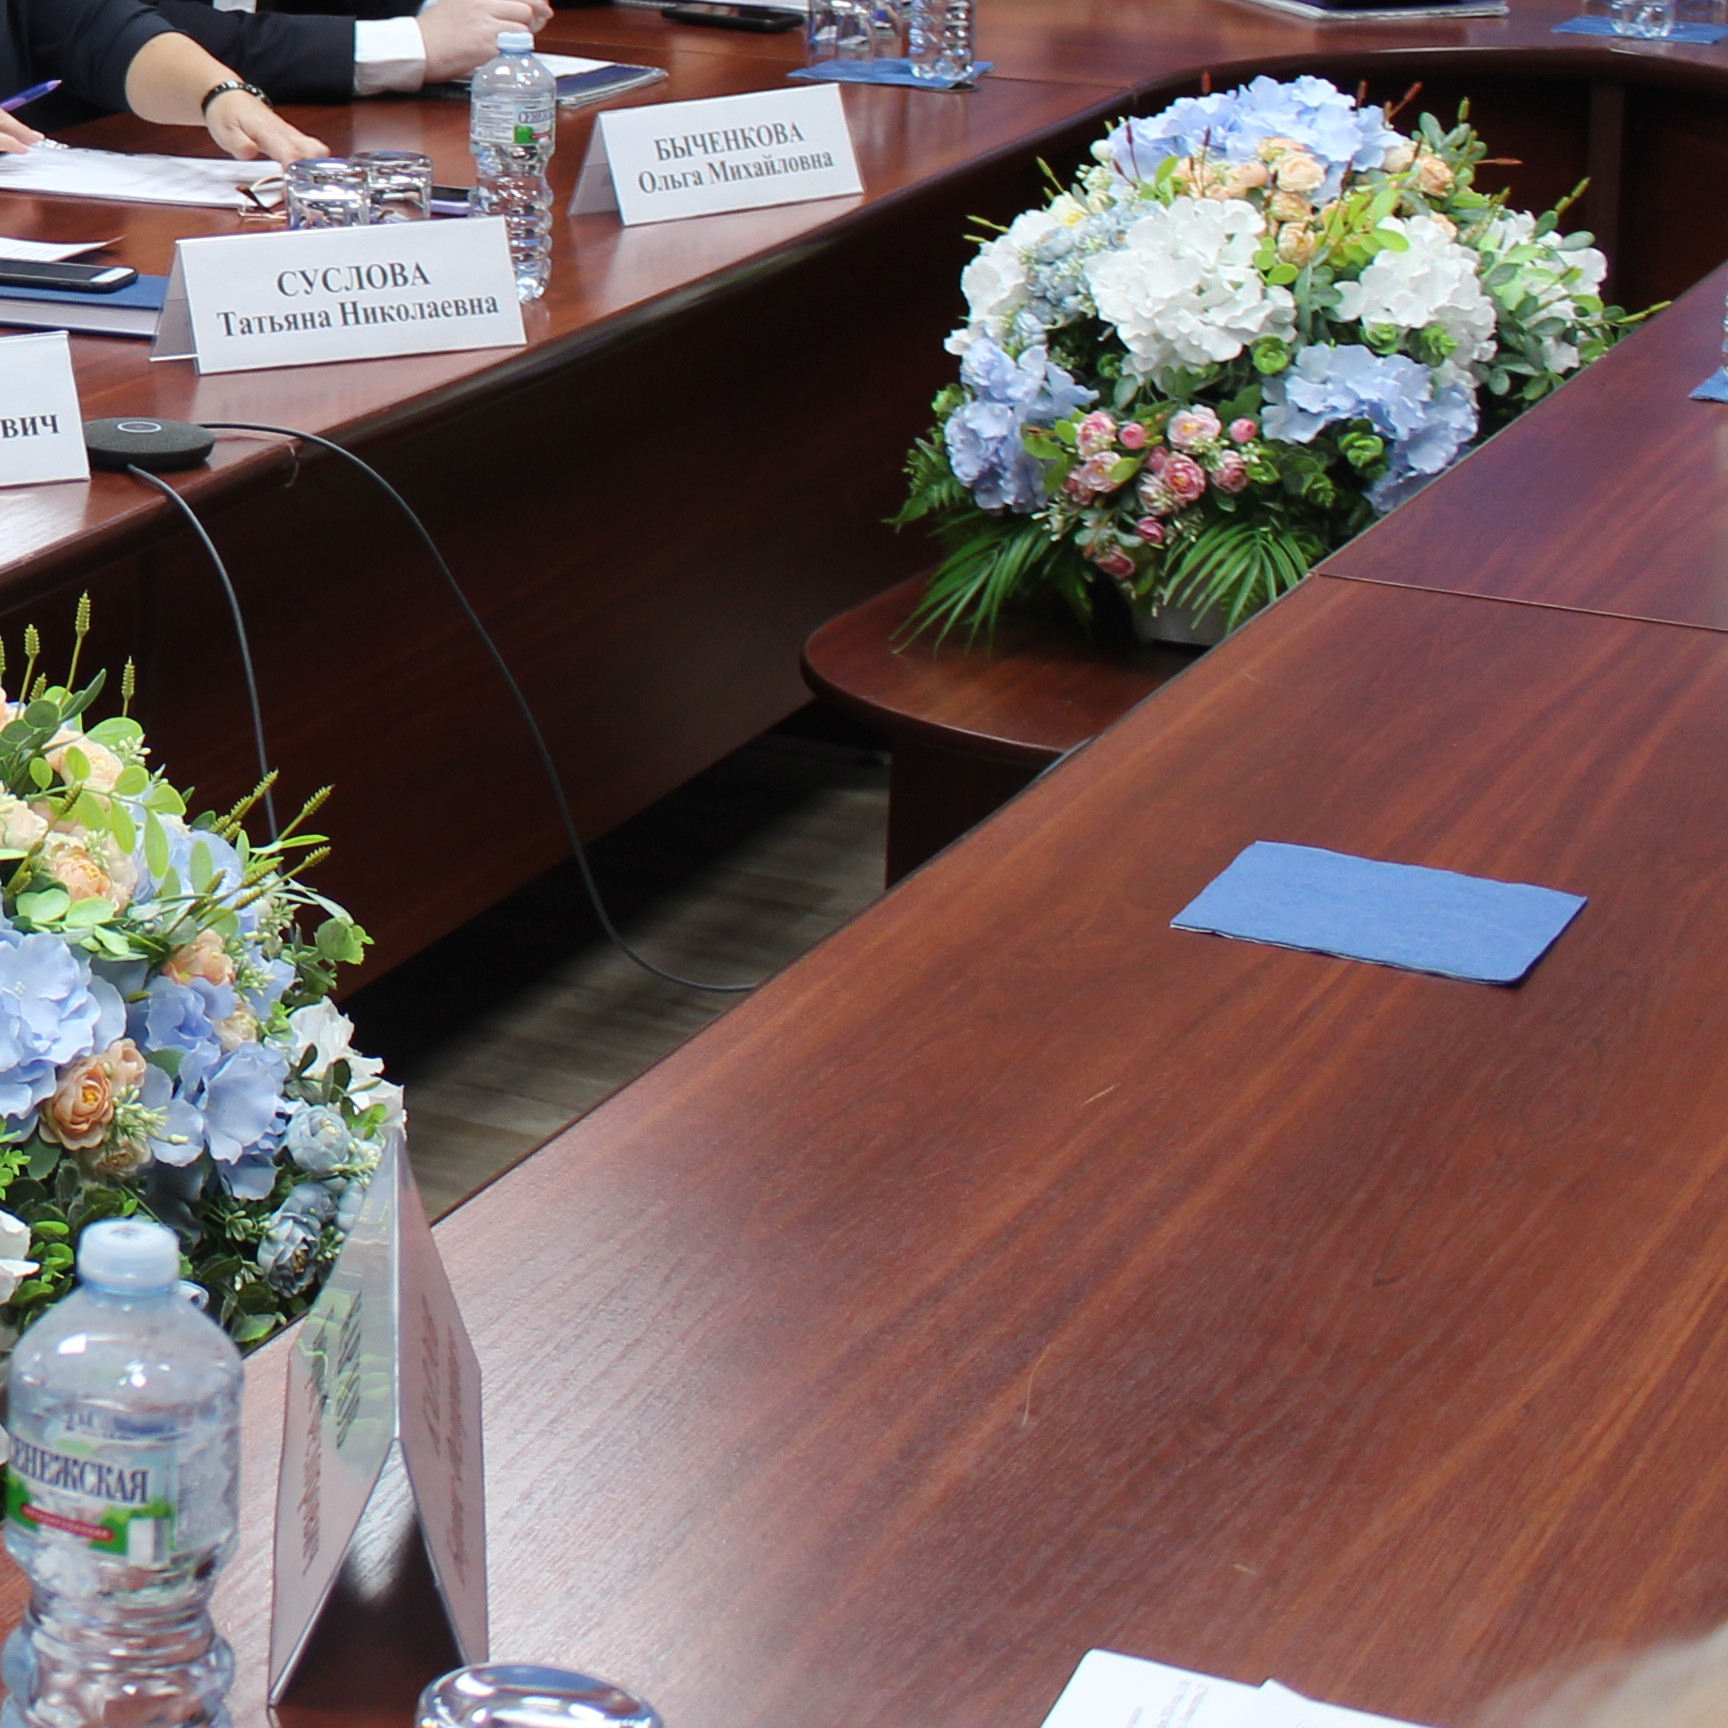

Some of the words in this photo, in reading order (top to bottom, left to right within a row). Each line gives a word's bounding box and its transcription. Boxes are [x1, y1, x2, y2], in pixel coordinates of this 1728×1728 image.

[653, 121, 805, 162] БЫЧЕНКОВА
[638, 169, 704, 195] Ольга
[706, 151, 834, 186] Михайловна
[276, 260, 432, 297] СУСЛОВА
[217, 308, 332, 338] Татьяна
[338, 294, 500, 329] Николаевна
